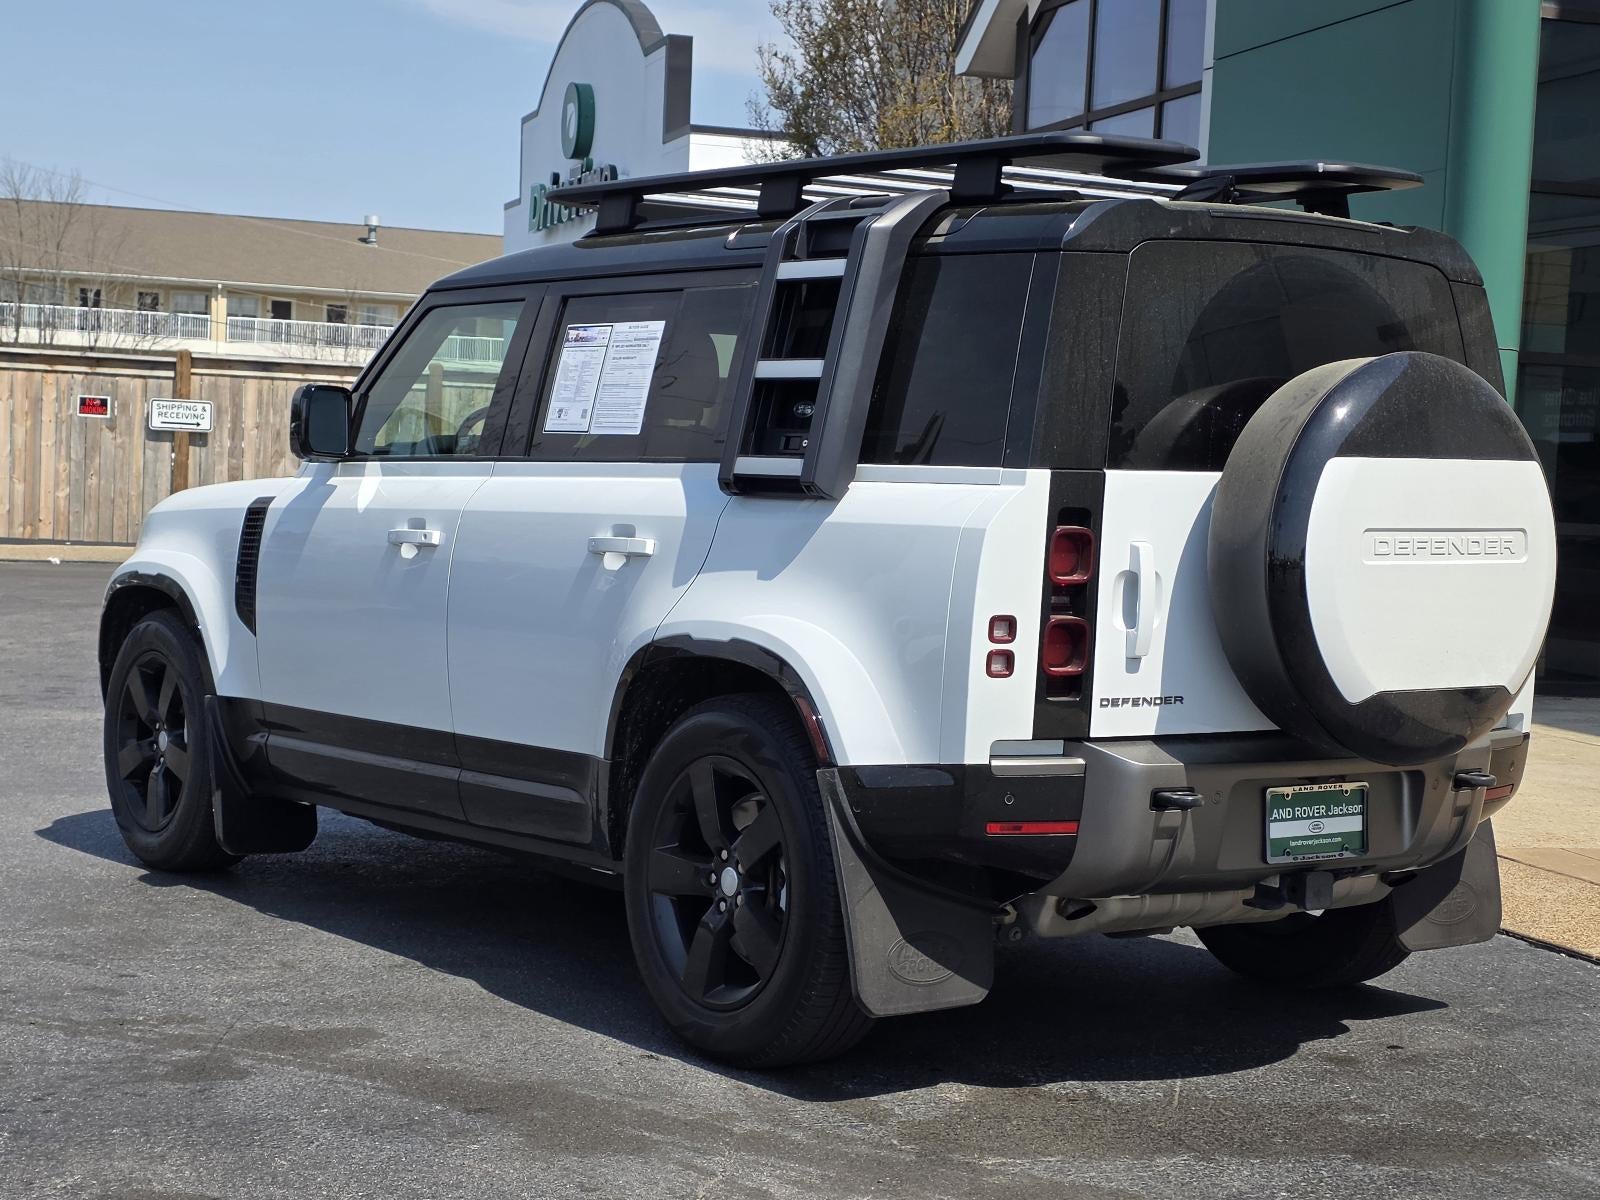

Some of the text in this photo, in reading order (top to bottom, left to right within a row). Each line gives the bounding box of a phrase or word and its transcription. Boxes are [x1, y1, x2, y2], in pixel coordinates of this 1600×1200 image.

[80, 405, 107, 415] SMOKING
[156, 403, 207, 413] SHIPPING &
[157, 411, 205, 420] RECEIVING
[1373, 537, 1515, 556] DEFENDER
[1099, 695, 1184, 708] DEFENDER
[1270, 803, 1363, 820] AND ROVER Jackson
[1289, 837, 1342, 846] landroverjackson.com
